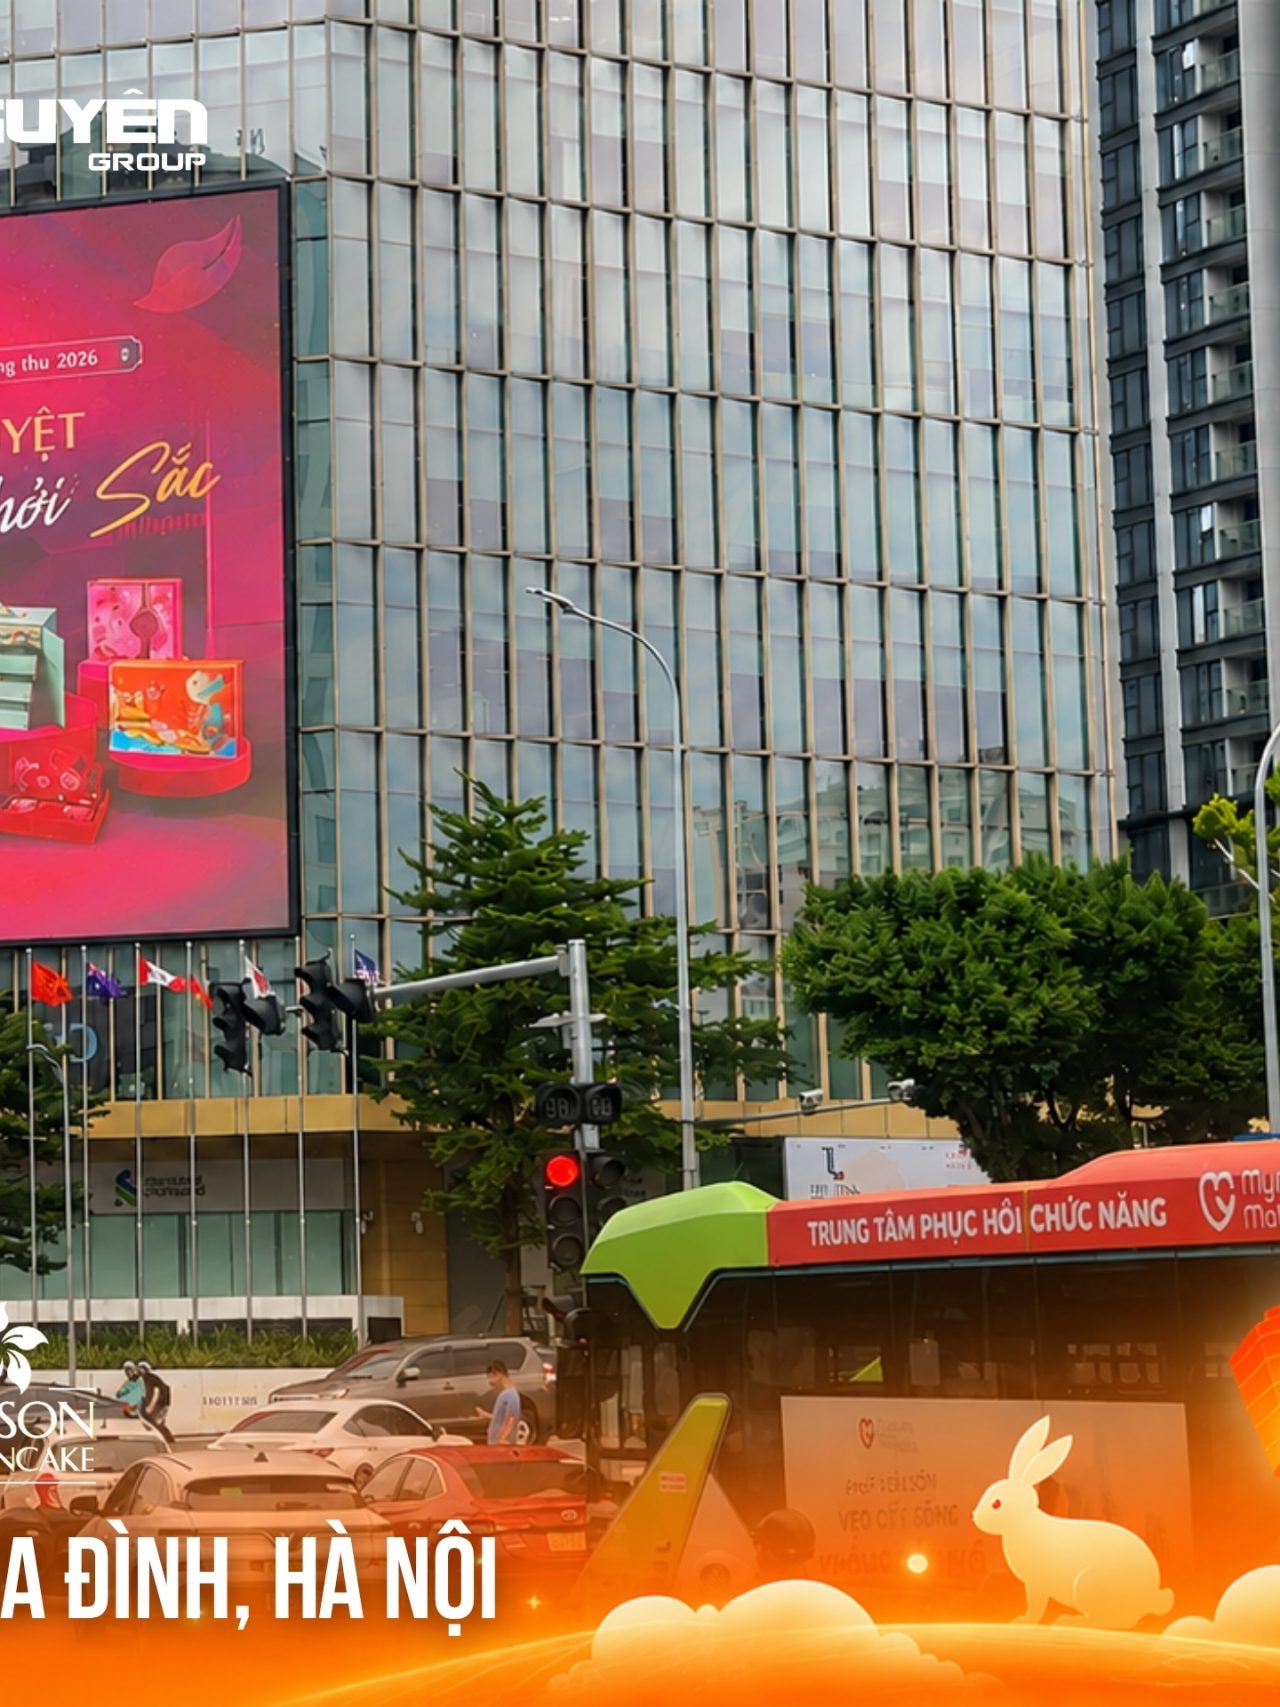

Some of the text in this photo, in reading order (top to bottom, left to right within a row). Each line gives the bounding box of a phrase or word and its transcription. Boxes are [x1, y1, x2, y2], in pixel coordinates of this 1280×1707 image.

[21, 353, 50, 372] thu
[56, 349, 99, 368] 2026
[89, 440, 221, 539] Sắc
[807, 1217, 869, 1247] TRUNG
[873, 1208, 915, 1242] TÂM
[921, 1209, 978, 1245] PHỤC
[1030, 1195, 1093, 1233] CHỨC
[1098, 1190, 1168, 1230] NĂNG
